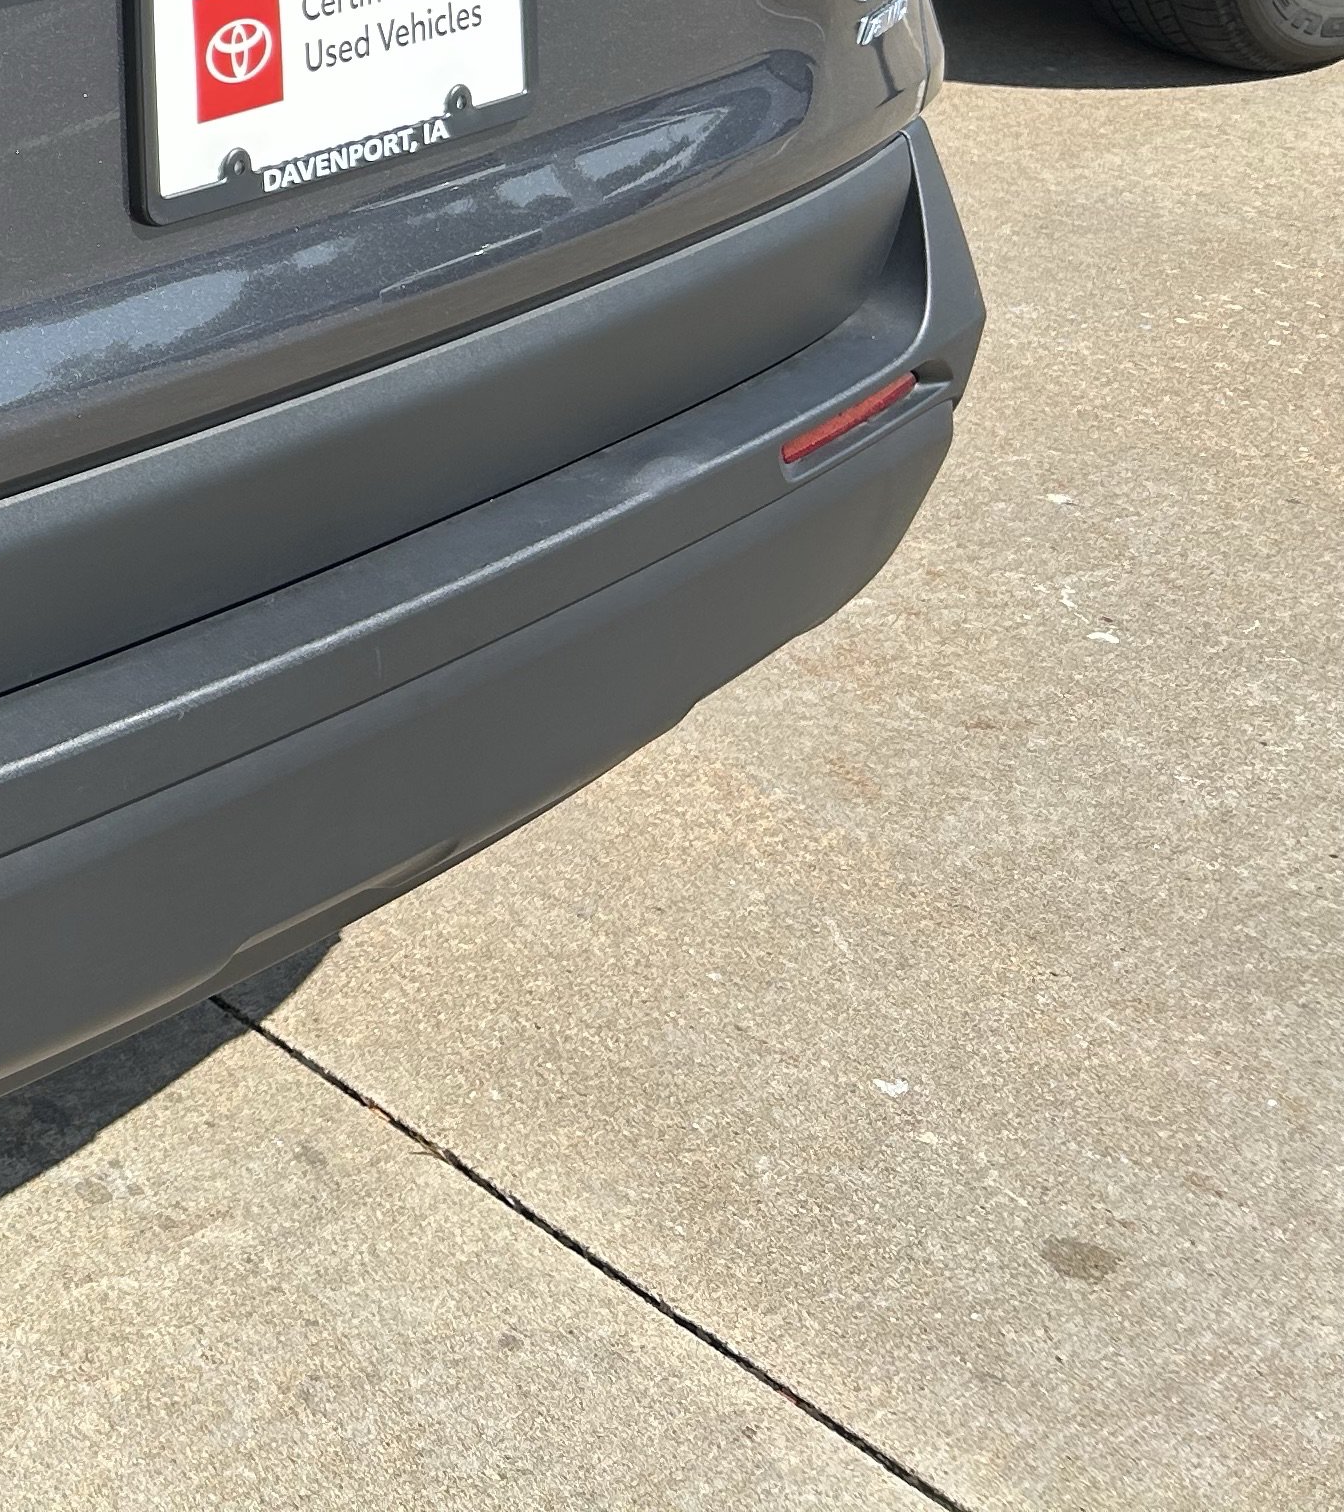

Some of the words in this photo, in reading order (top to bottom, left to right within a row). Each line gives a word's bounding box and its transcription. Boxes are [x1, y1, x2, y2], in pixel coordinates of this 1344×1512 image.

[304, 25, 370, 72] Used
[377, 2, 483, 52] Vehicles
[262, 126, 419, 194] DAVENPORT,
[422, 119, 451, 145] IA
